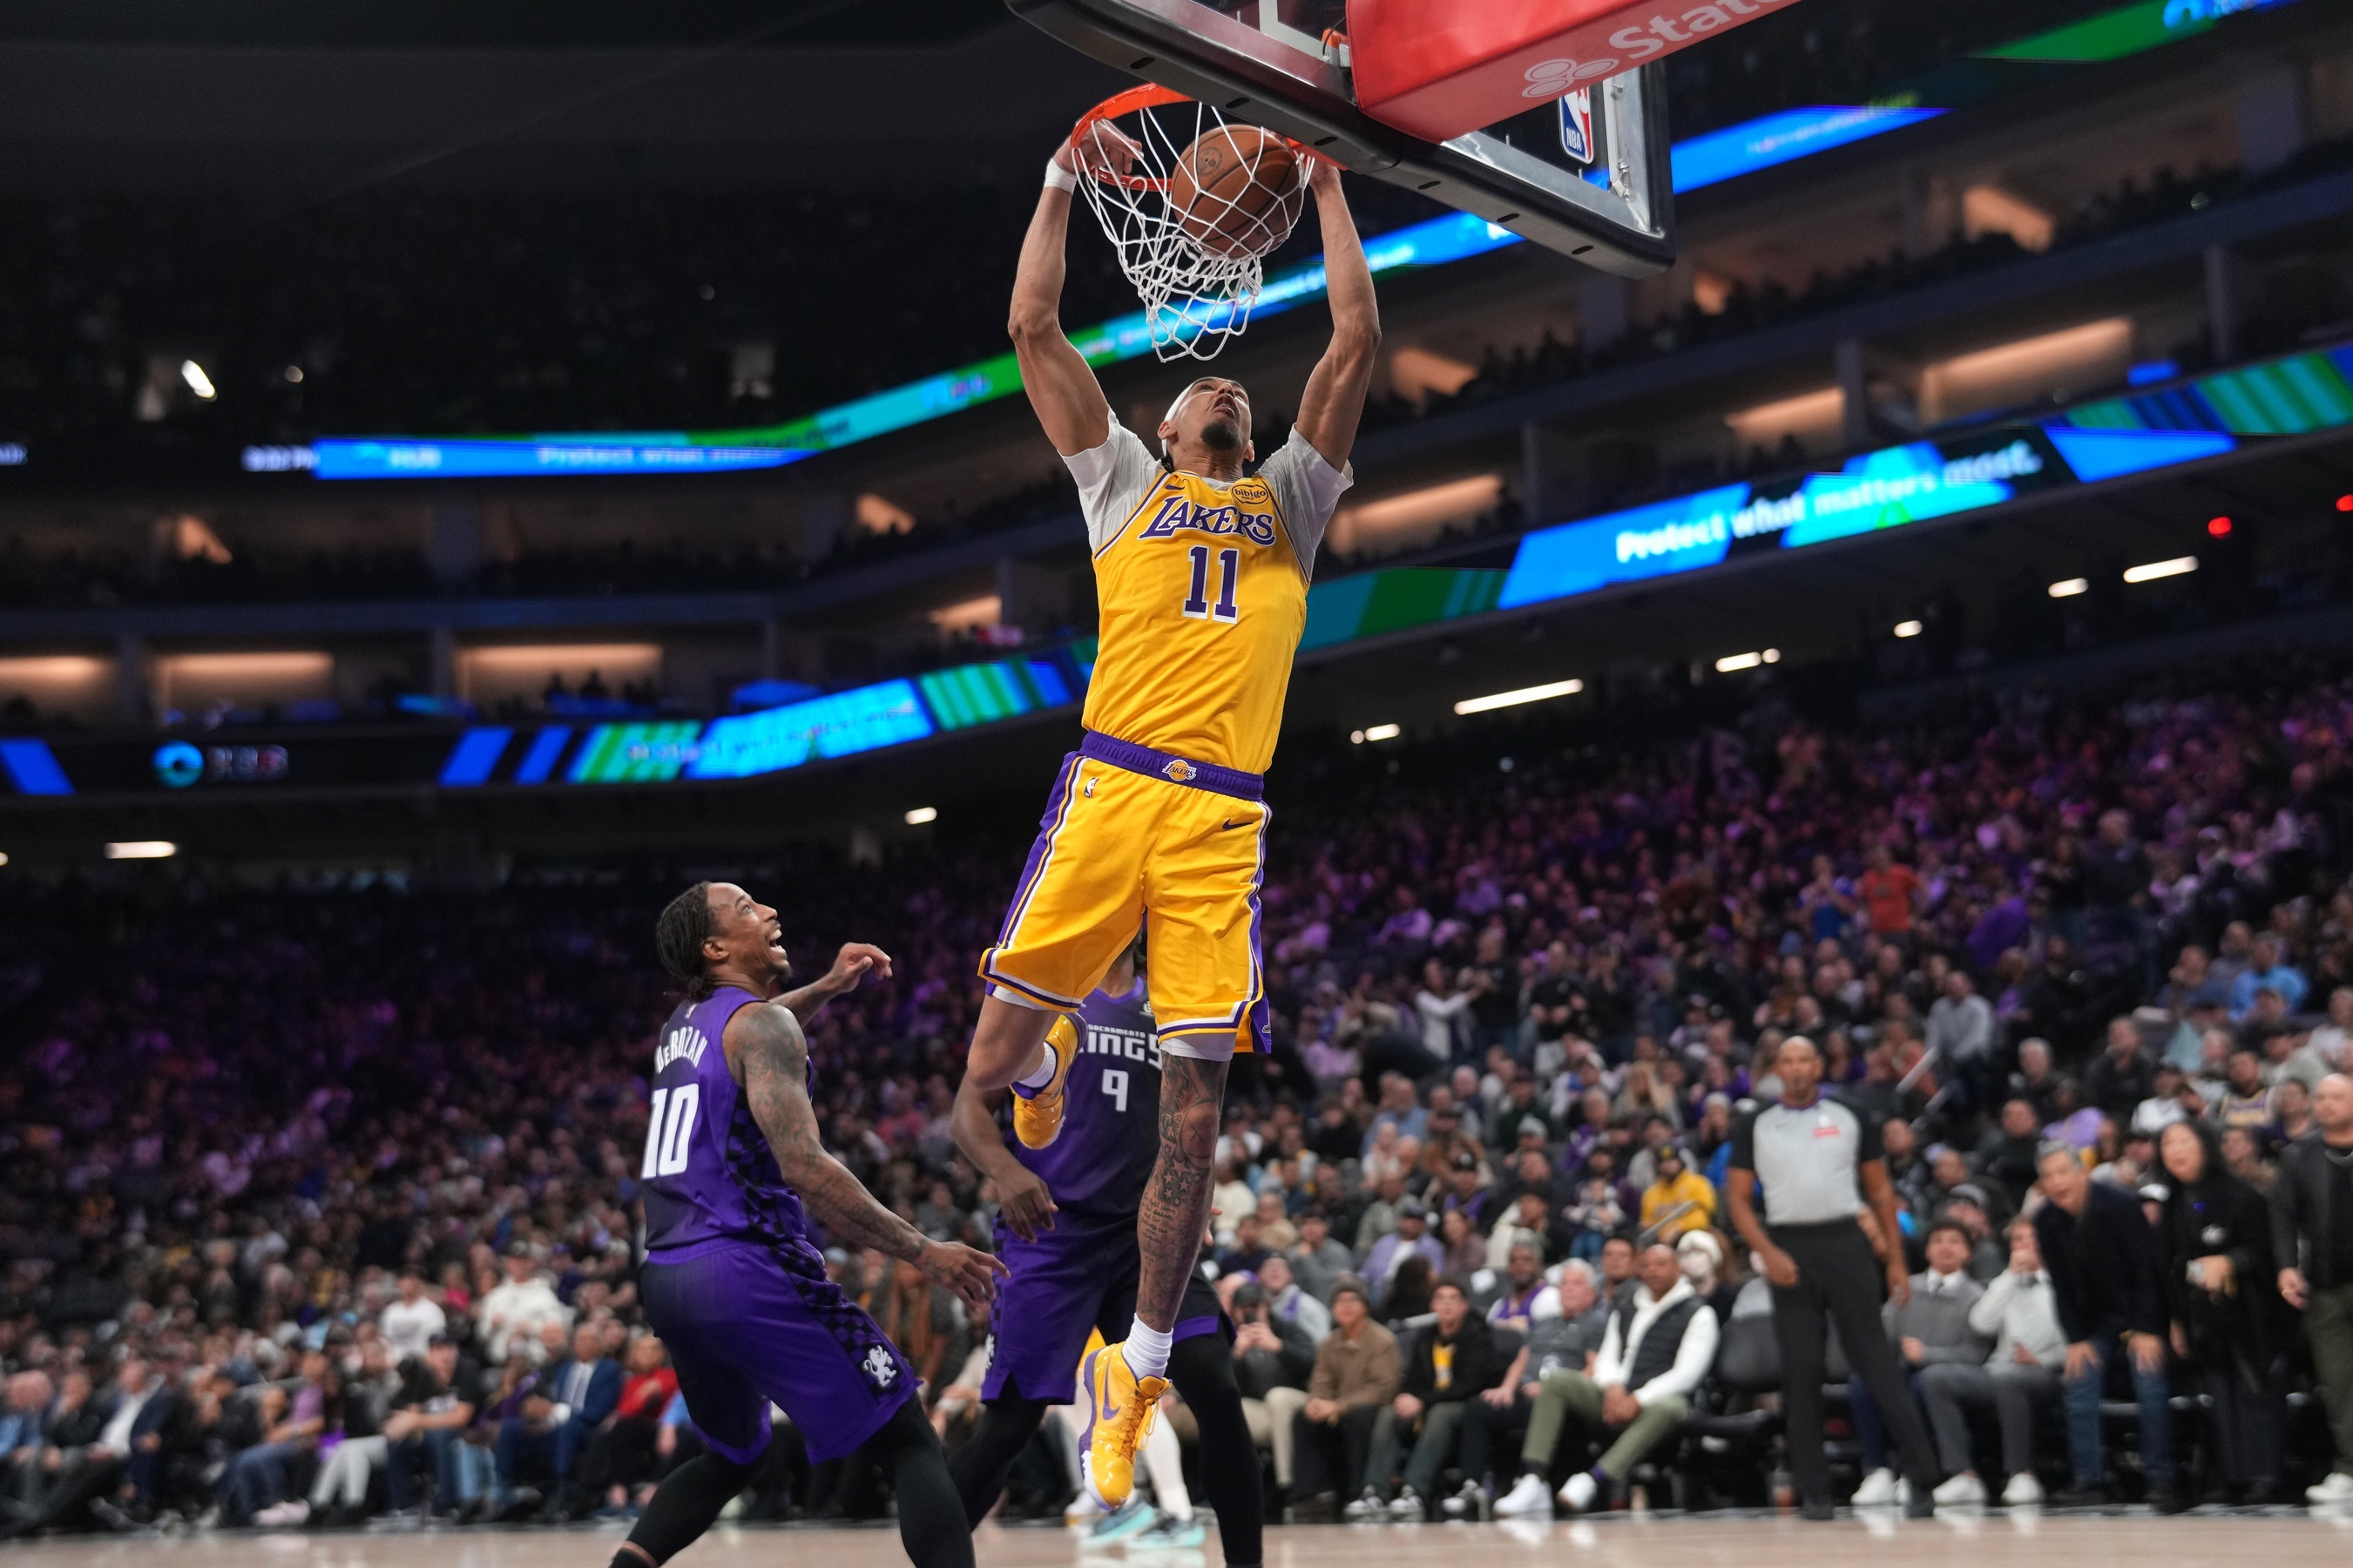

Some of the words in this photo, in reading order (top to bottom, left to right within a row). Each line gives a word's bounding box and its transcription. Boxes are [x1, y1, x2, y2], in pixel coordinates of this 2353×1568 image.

[1608, 0, 1782, 59] Stat
[1565, 127, 1582, 152] NBA
[1234, 489, 1266, 498] bibigo
[1138, 496, 1276, 546] LAKERS
[1616, 511, 1727, 563] Protect
[1732, 490, 1806, 538] what
[1815, 471, 1937, 517] matters
[1182, 544, 1240, 624] 11
[1162, 762, 1196, 780] LAKERS
[1088, 1024, 1146, 1037] SACRAMENTO
[1101, 1069, 1129, 1112] 9
[640, 1083, 700, 1179] 10
